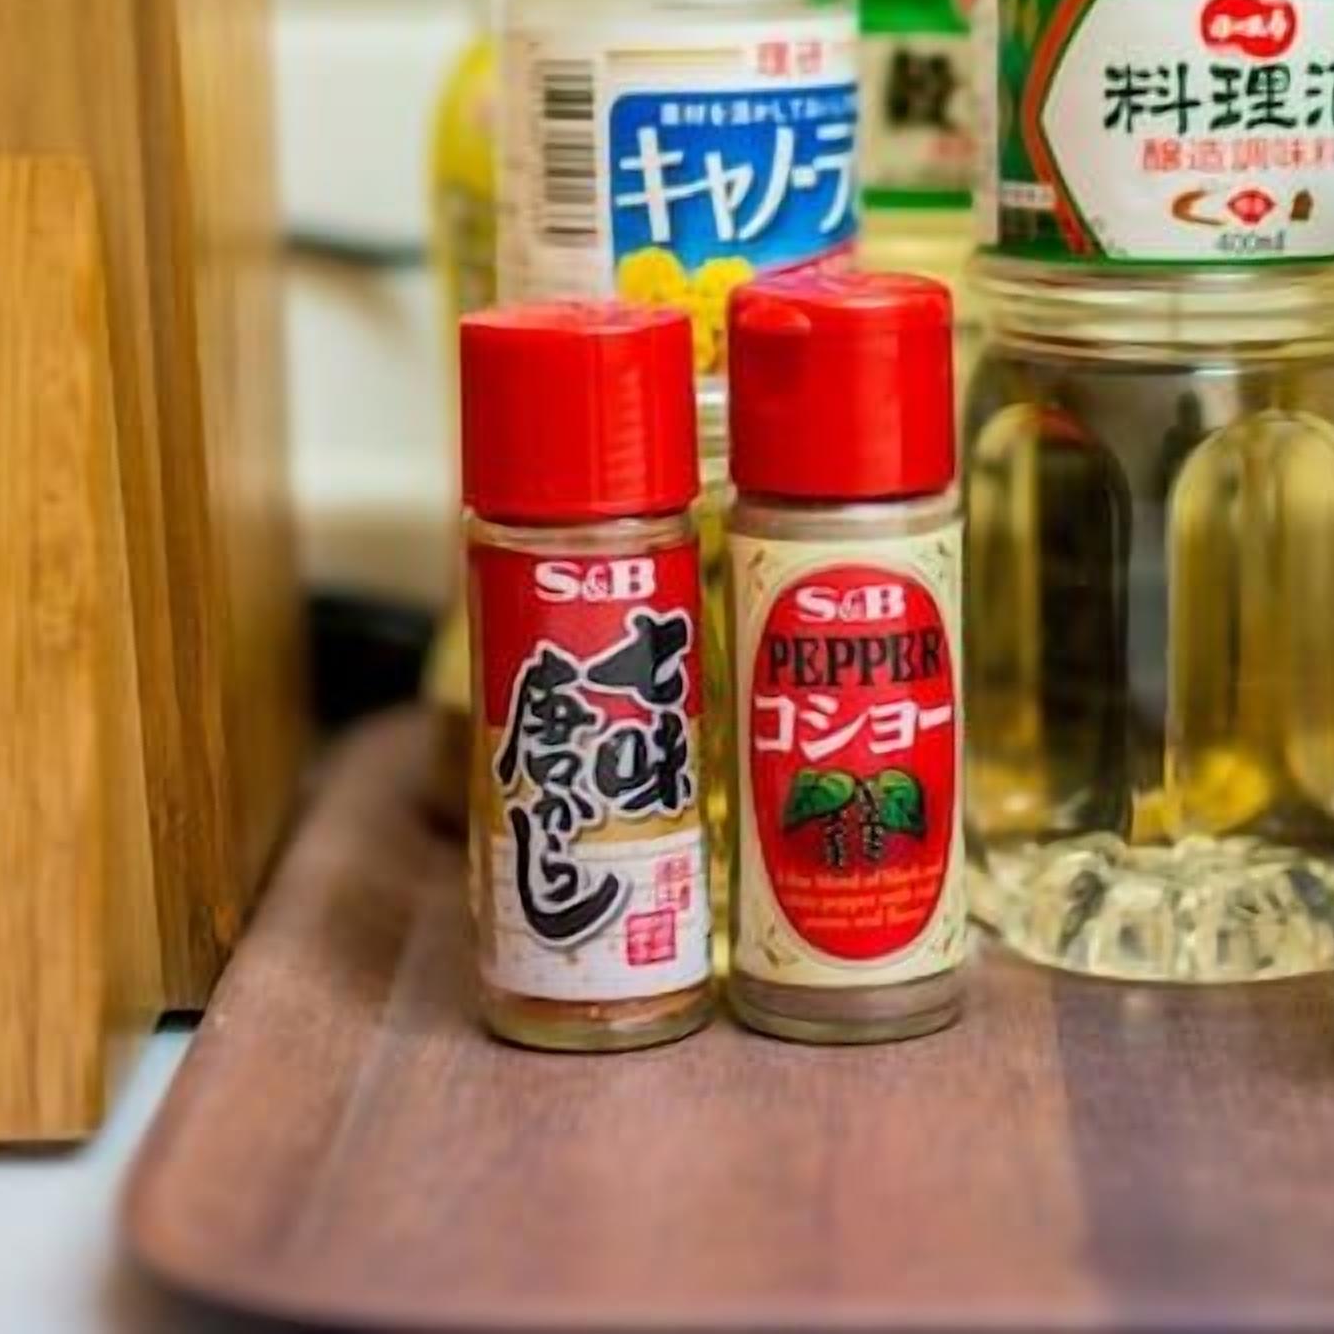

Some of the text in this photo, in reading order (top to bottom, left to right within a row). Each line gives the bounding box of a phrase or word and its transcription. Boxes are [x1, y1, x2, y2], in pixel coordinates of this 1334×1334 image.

[613, 123, 855, 244] キャノーラ
[534, 556, 656, 603] S&B
[793, 583, 907, 624] S&B
[766, 625, 945, 688] PEPPER
